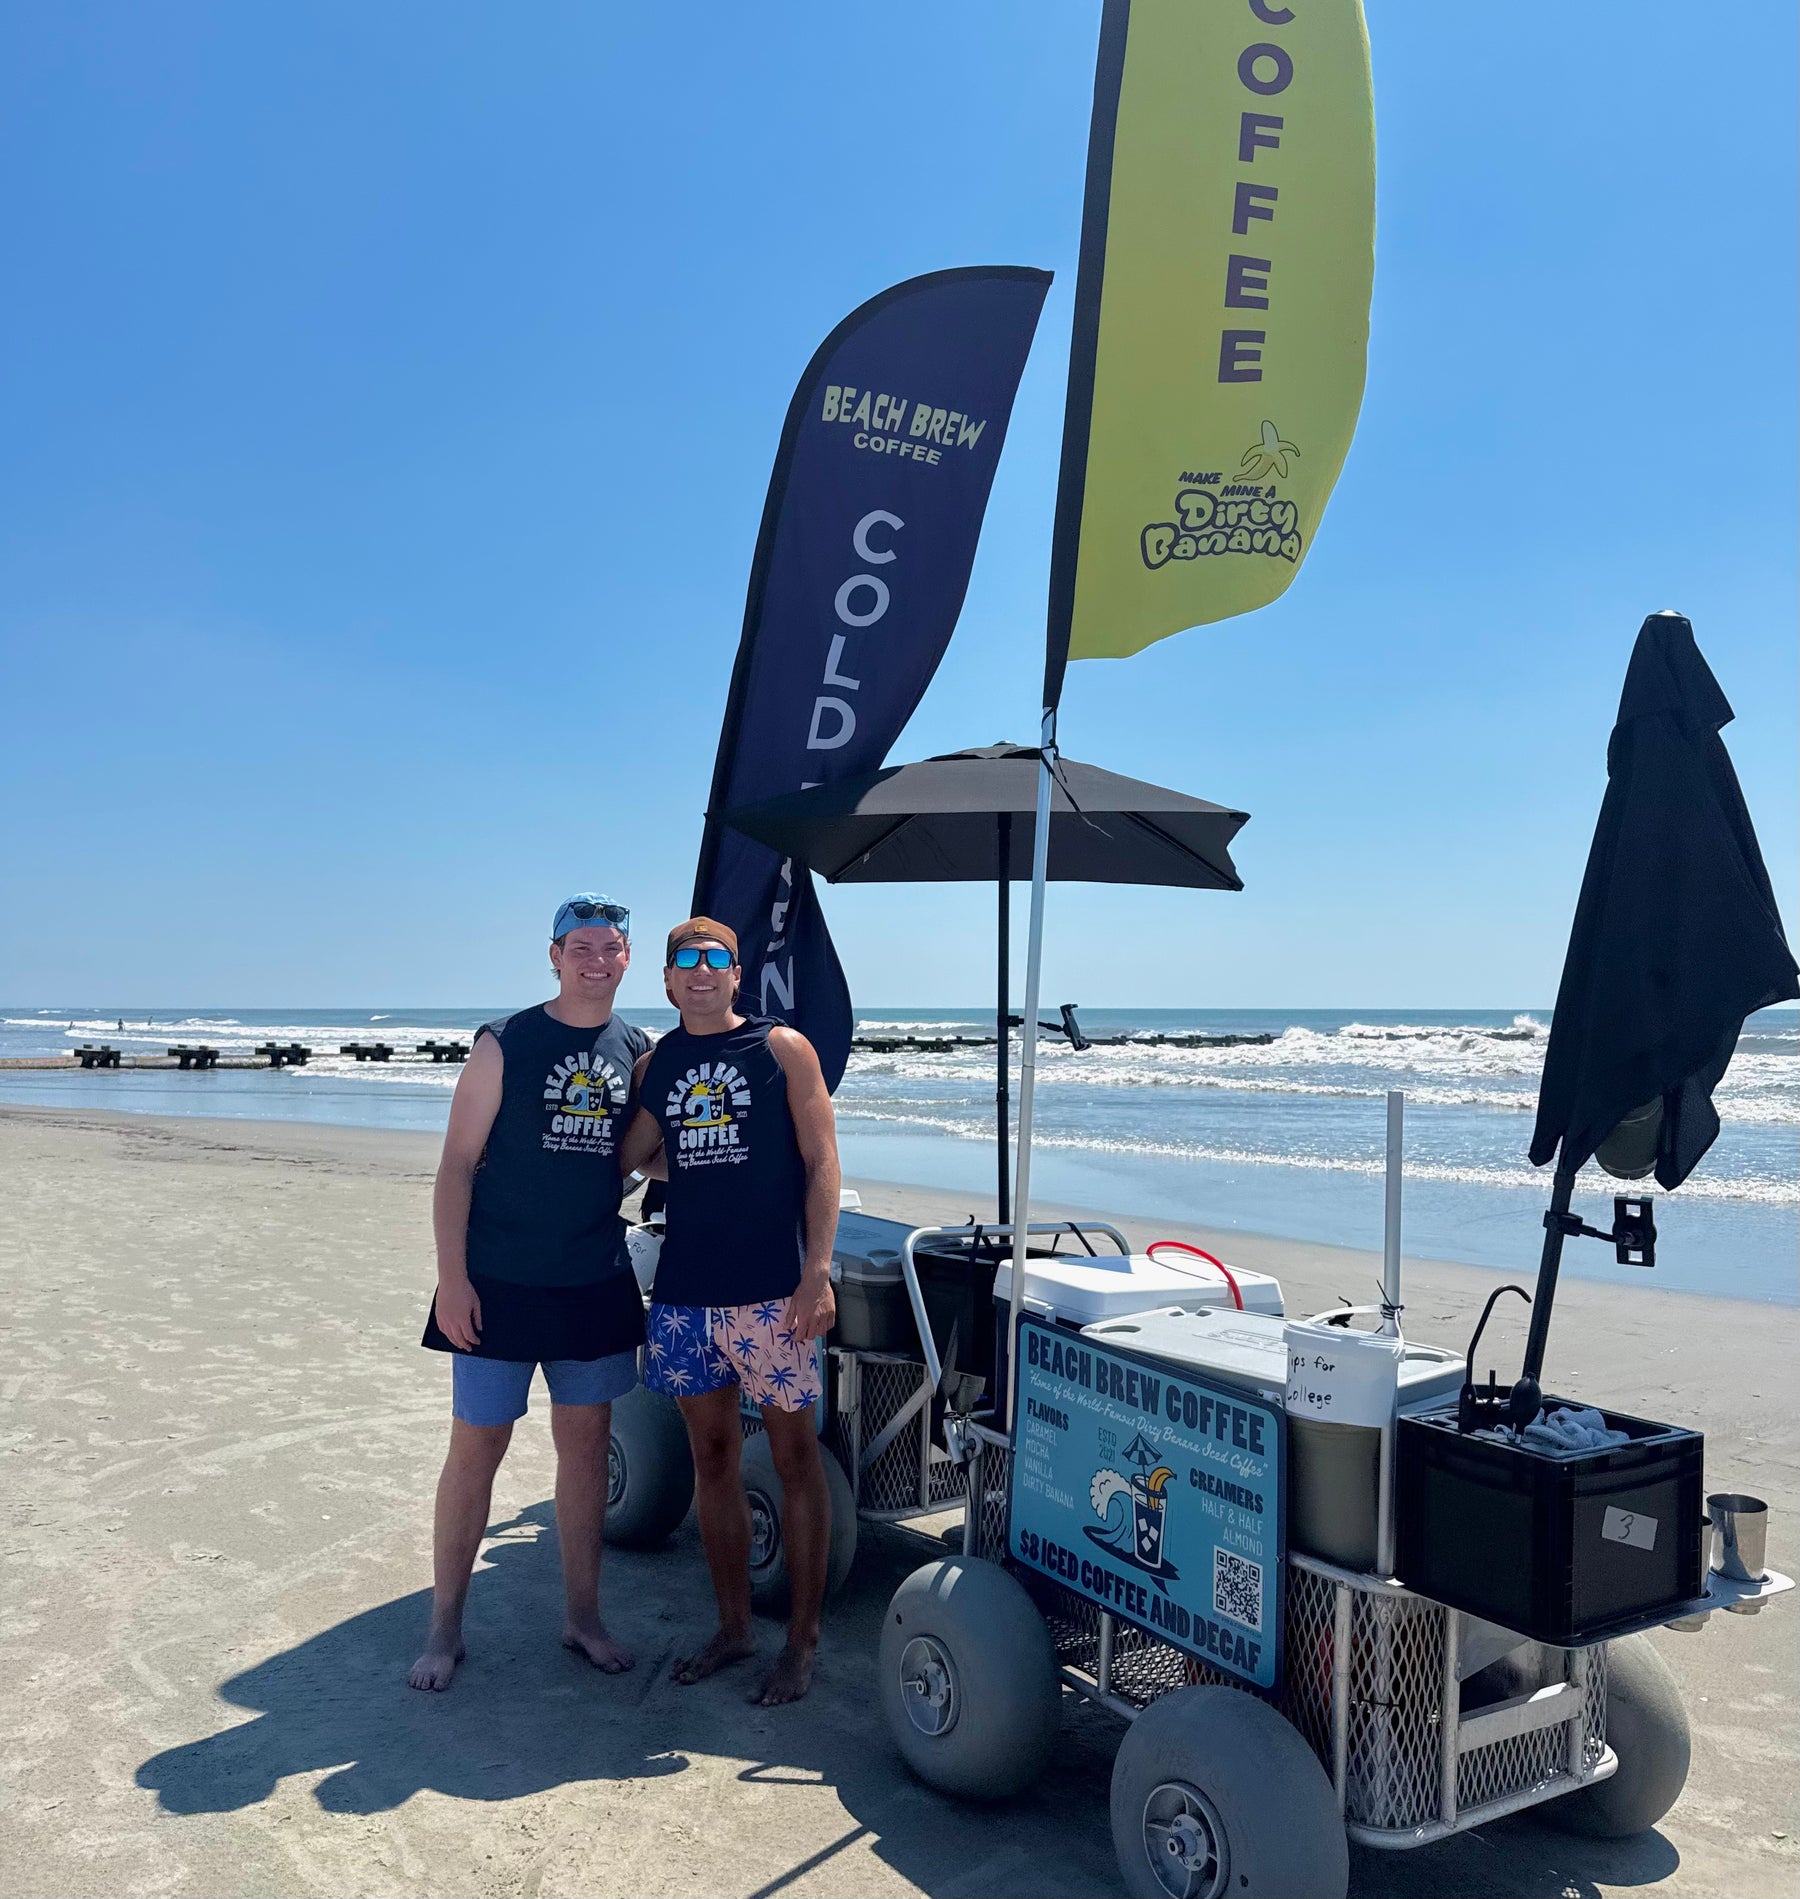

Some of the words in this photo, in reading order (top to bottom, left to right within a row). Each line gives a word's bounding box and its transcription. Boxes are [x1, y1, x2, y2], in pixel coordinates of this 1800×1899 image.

[822, 385, 908, 433] BEACH
[909, 403, 987, 450] BREW
[853, 432, 942, 465] COFFEE
[1178, 471, 1223, 484] MAKE
[1220, 485, 1263, 497] MINE
[1265, 485, 1276, 498] A
[1175, 489, 1298, 535] Dirty
[1141, 522, 1302, 570] Banana
[806, 509, 905, 749] COLD
[544, 1052, 590, 1100] BEACH
[592, 1054, 627, 1105] BREW
[666, 1062, 710, 1117] BEACH
[713, 1061, 751, 1106] BREW
[551, 1114, 613, 1138] COFFEE
[679, 1124, 740, 1150] COFFEE
[1313, 1355, 1335, 1371] for
[1028, 1330, 1092, 1389] BEACH
[1096, 1356, 1160, 1416] BREW
[1166, 1384, 1265, 1457] COFFEE
[1027, 1397, 1069, 1431] FLAVORS
[1053, 1383, 1062, 1400] of
[1062, 1386, 1076, 1401] the
[1136, 1415, 1162, 1443] Dirty
[1162, 1426, 1200, 1453] Banana
[1201, 1442, 1229, 1465] Iced
[1025, 1438, 1050, 1460] MOCHA
[1026, 1420, 1057, 1447] CARAMEL
[1025, 1455, 1053, 1481] VANILLA
[1023, 1473, 1045, 1494] DIRTY
[1045, 1483, 1075, 1510] BANANA
[1190, 1467, 1264, 1514] CREAMERS
[1201, 1497, 1225, 1520] HALF
[1227, 1508, 1235, 1525] &
[1238, 1512, 1264, 1536] HALF
[1617, 1514, 1635, 1540] 3
[1223, 1527, 1263, 1557] ALMOND
[1020, 1528, 1039, 1562] $8
[1041, 1538, 1079, 1582] ICED
[1081, 1560, 1148, 1619] COFFEE
[1150, 1594, 1190, 1639] AND
[1193, 1613, 1262, 1674] DECAF
